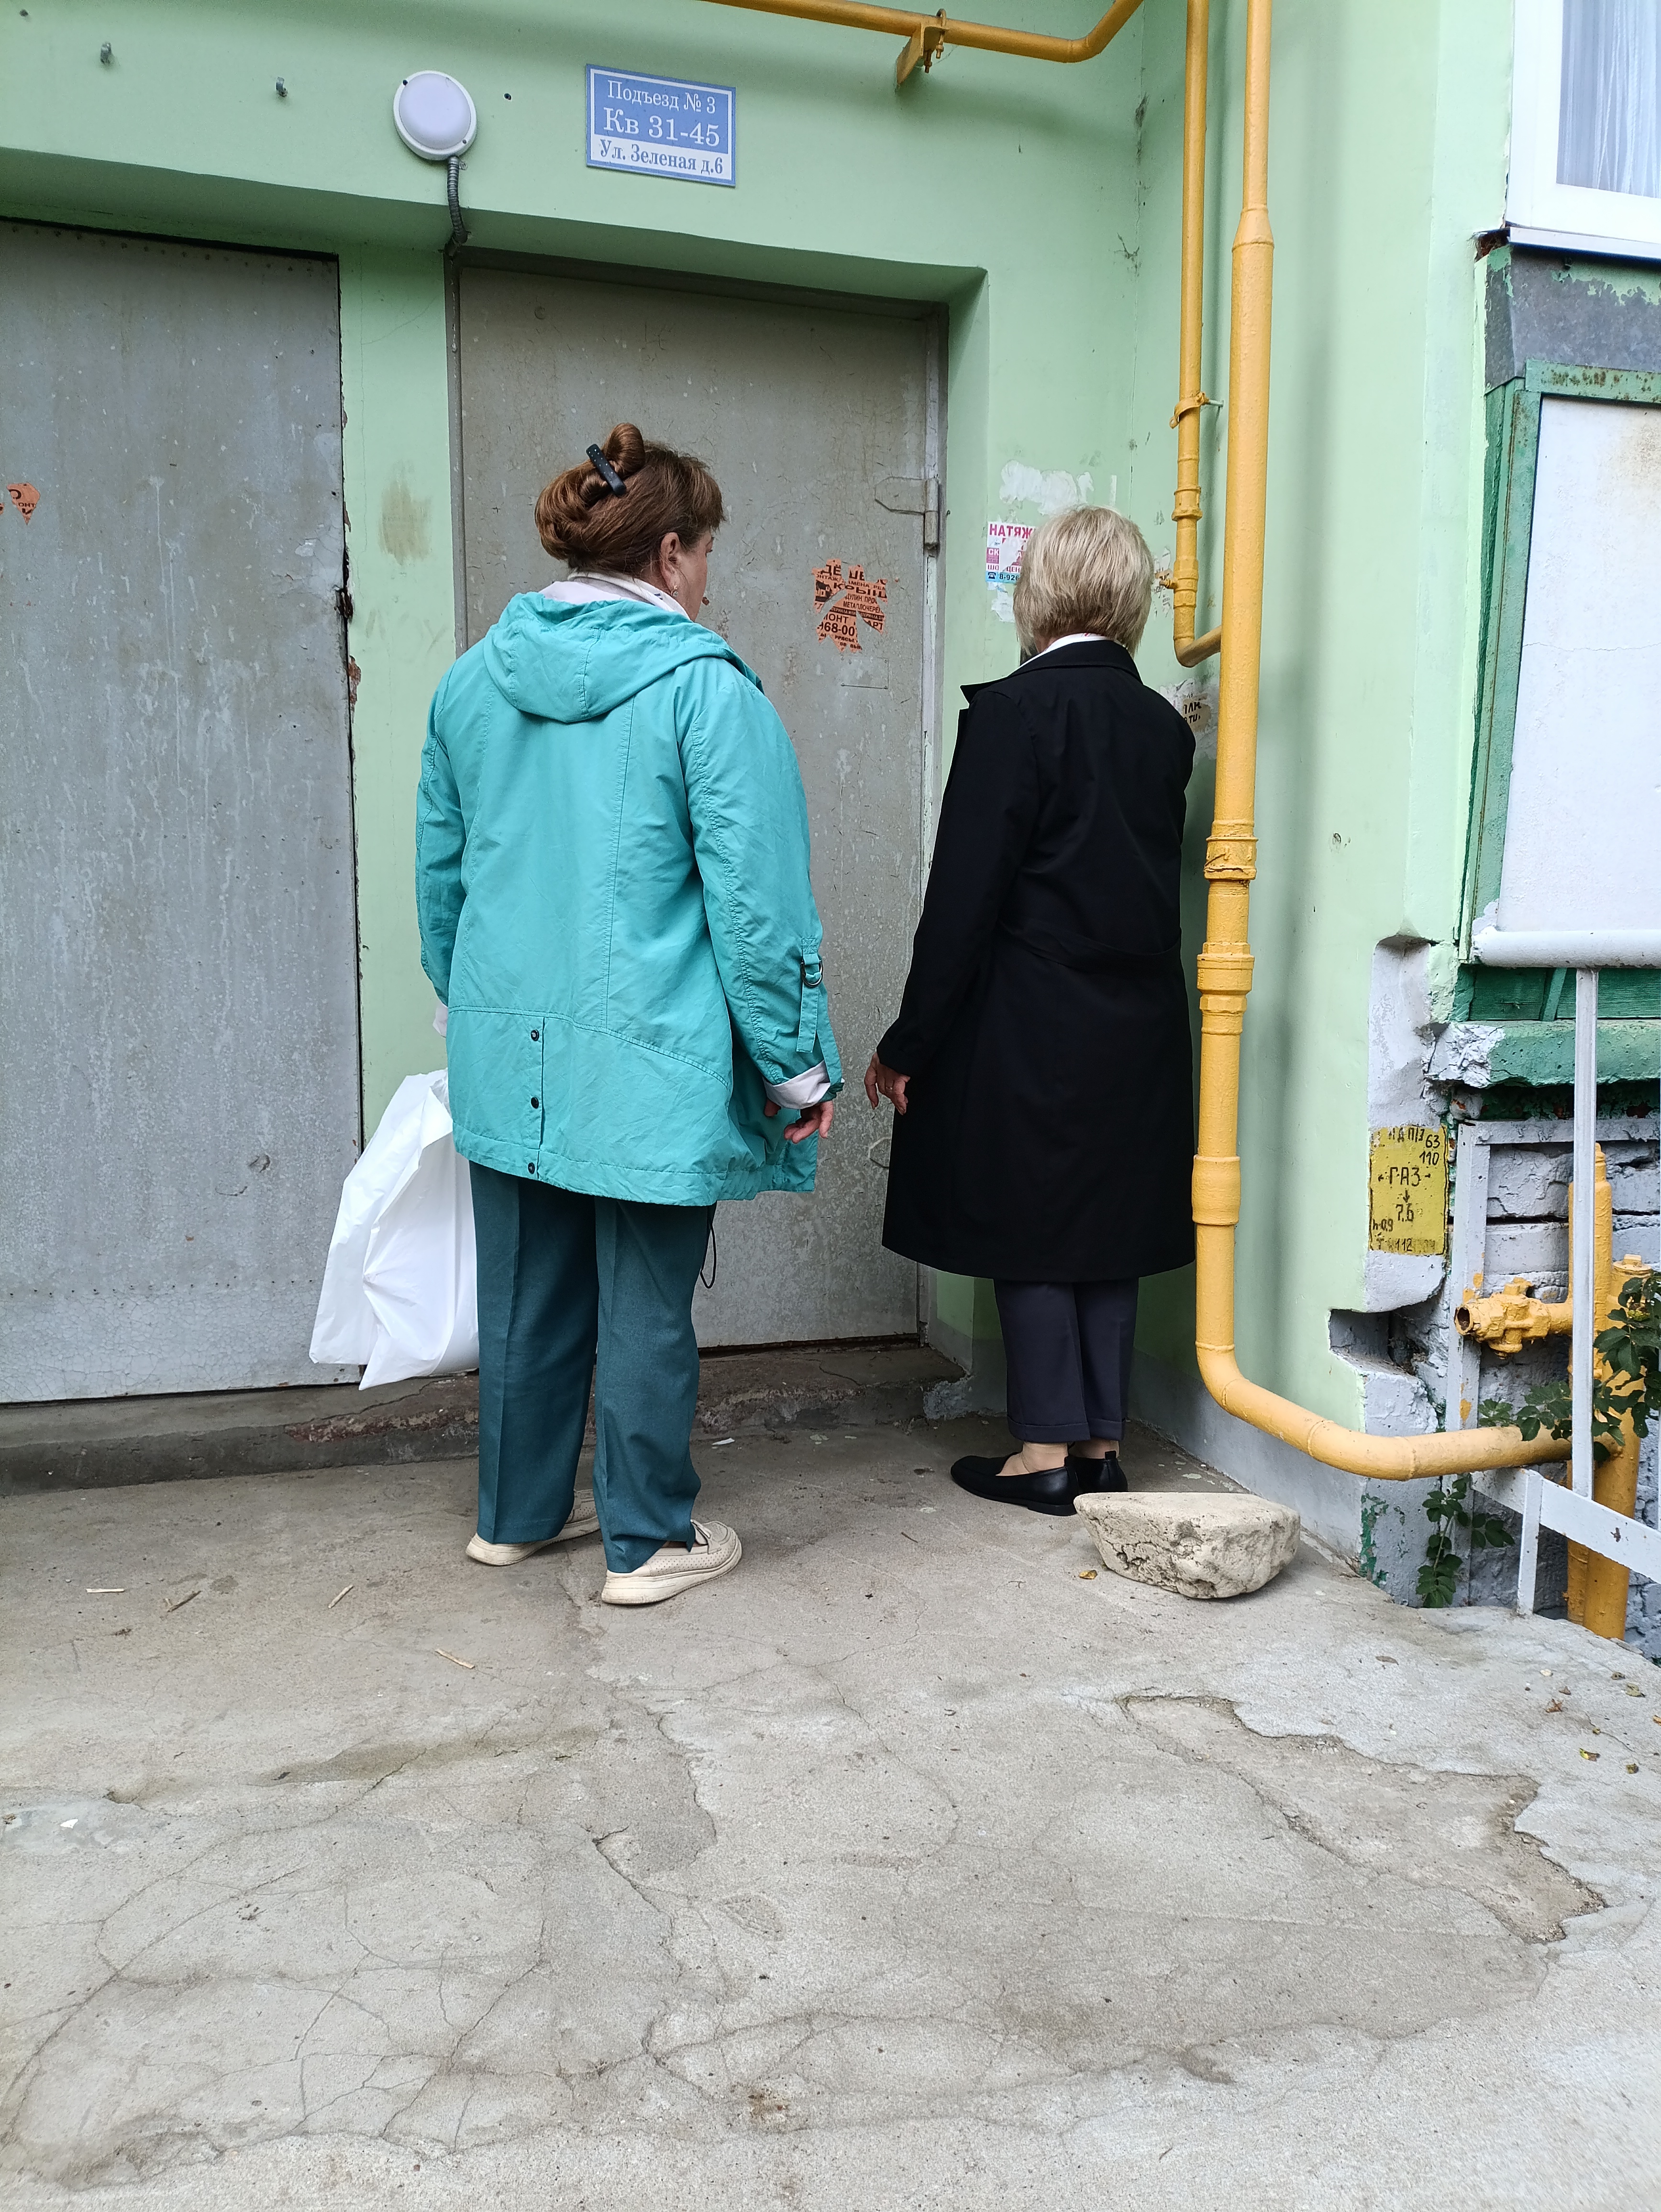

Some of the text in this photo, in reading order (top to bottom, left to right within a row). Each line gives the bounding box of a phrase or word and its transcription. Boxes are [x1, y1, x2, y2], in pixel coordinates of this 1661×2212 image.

[608, 80, 715, 113] Подъезд № 3
[604, 107, 720, 146] Кв 31-45
[600, 139, 723, 175] Ул. Зеленая д.6
[989, 524, 1034, 539] НАТЯЖ
[1426, 1134, 1440, 1148] 63
[1419, 1151, 1440, 1165] 110
[1390, 1167, 1420, 1186] ГАЗ
